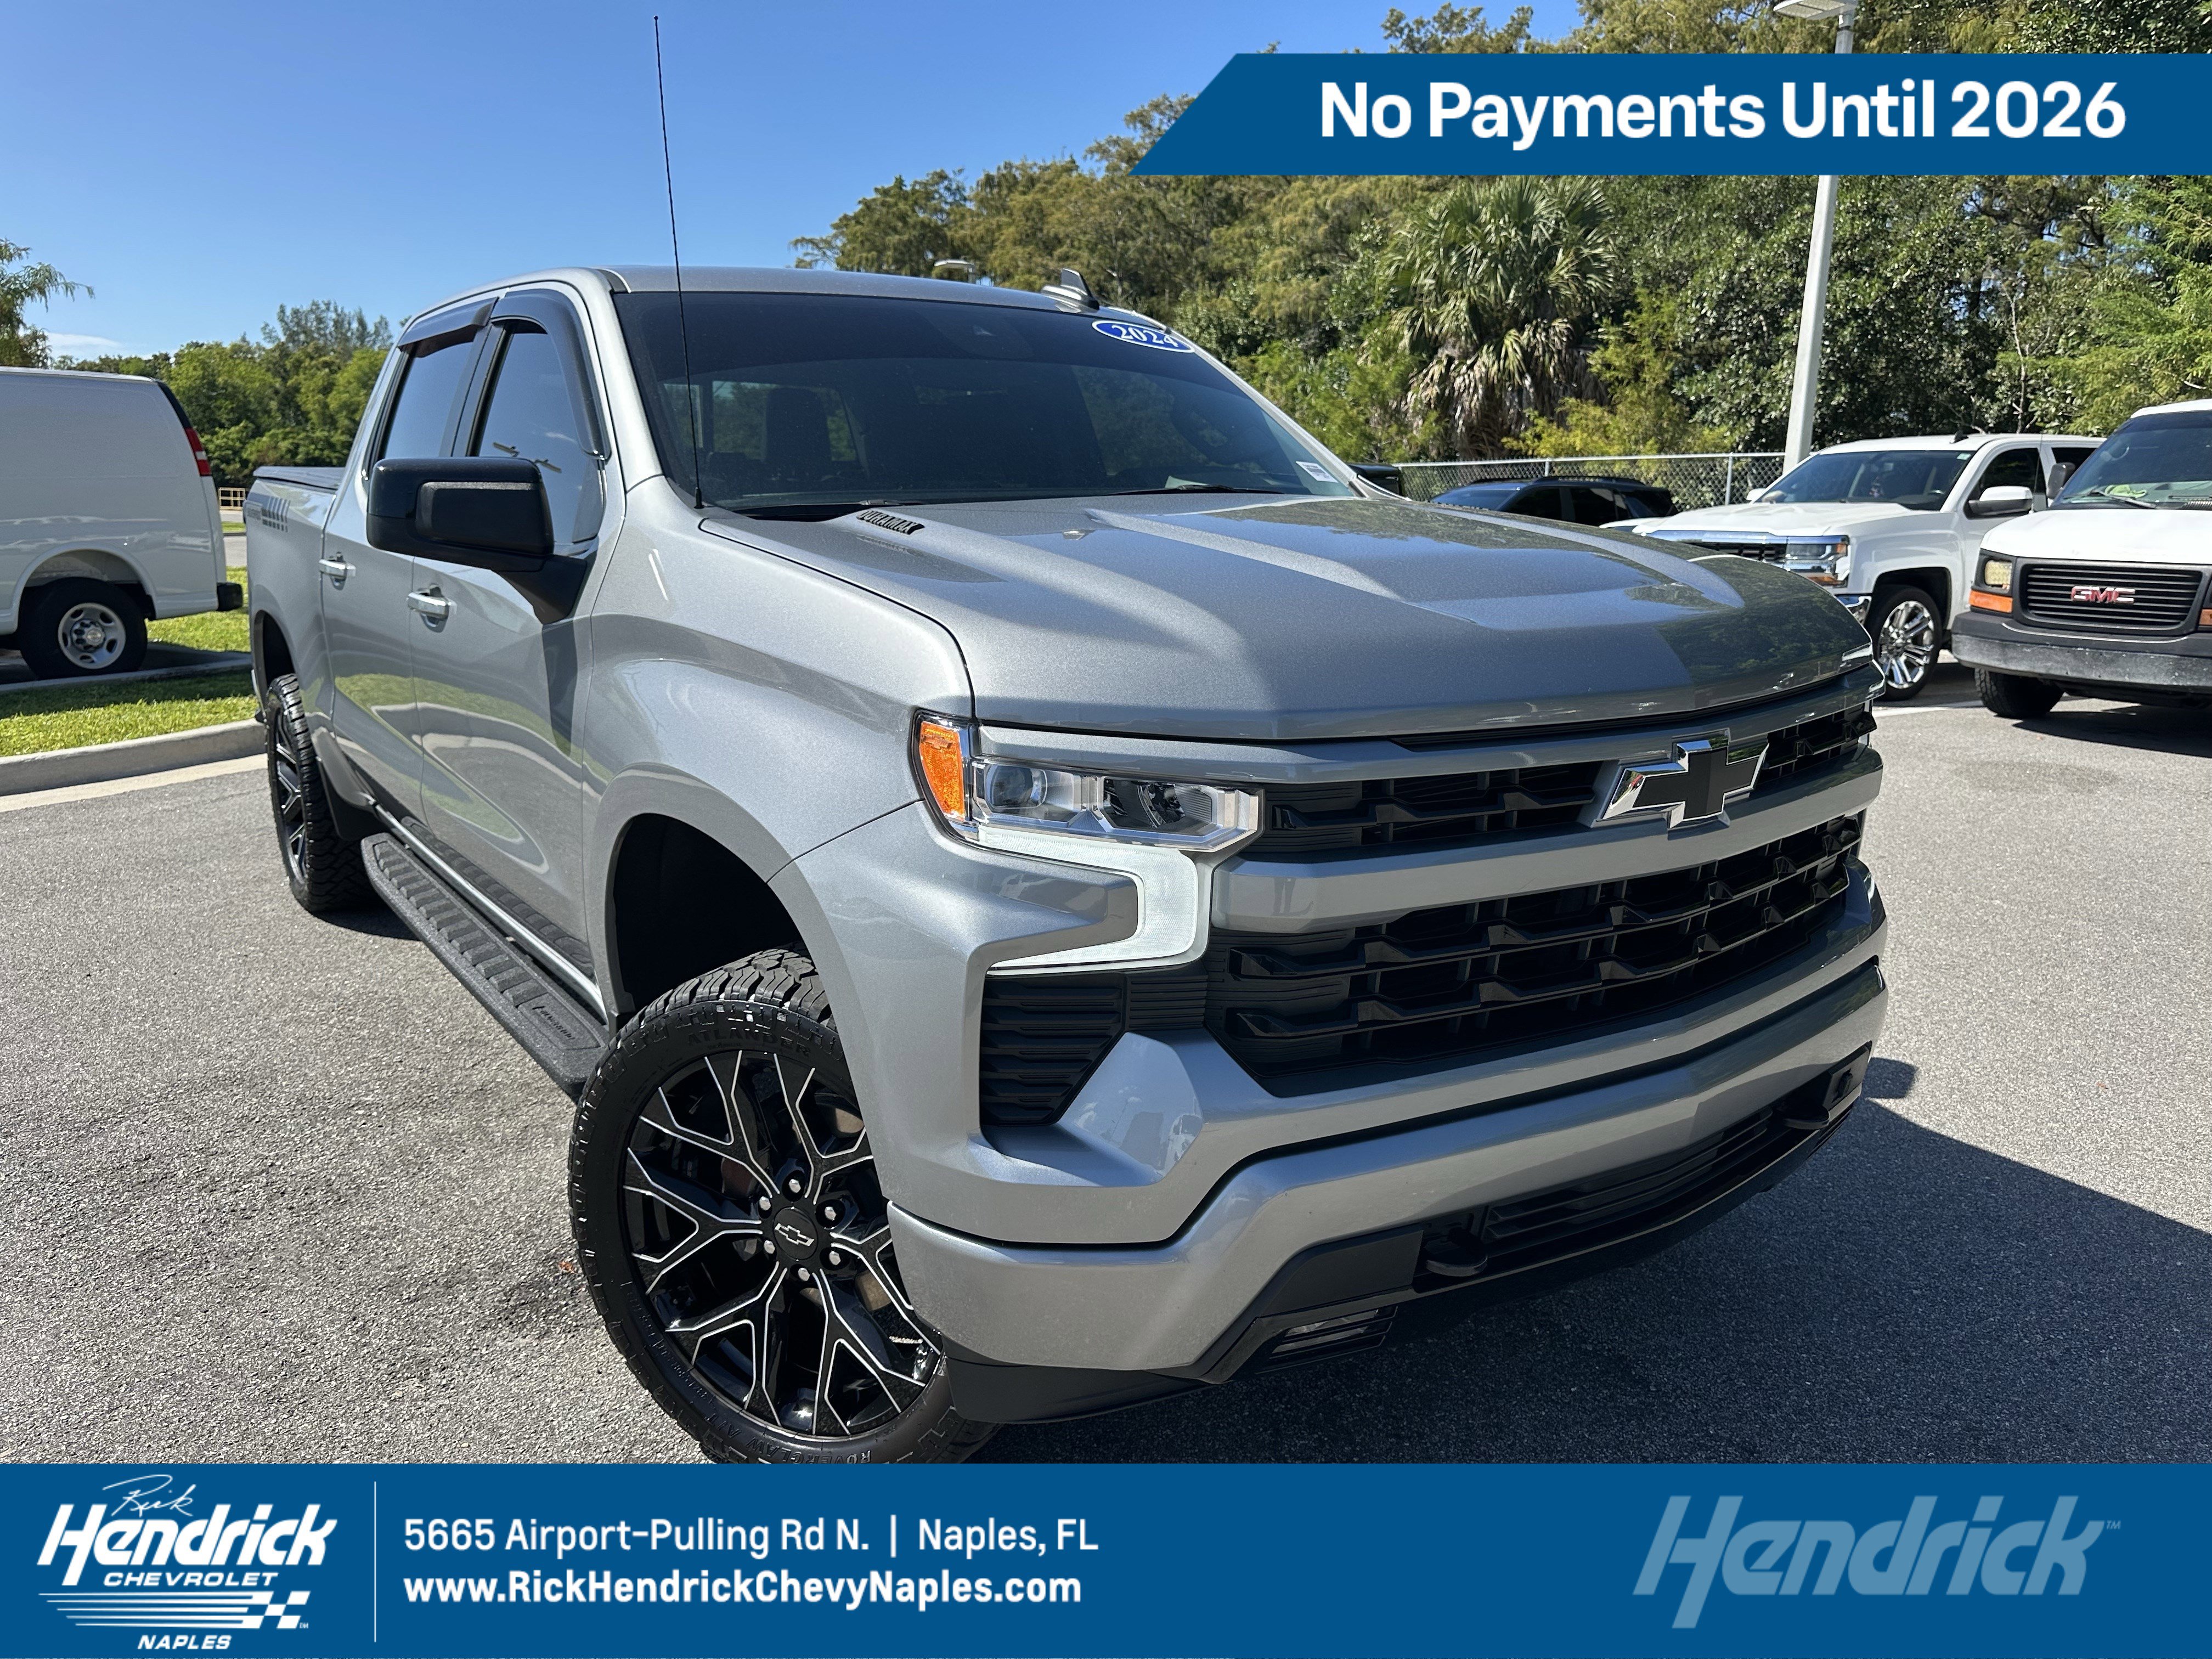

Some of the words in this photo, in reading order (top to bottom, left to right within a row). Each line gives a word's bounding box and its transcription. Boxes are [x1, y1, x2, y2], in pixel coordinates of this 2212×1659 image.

[1111, 324, 1179, 348] 2024
[856, 510, 921, 535] DURAMAX
[2070, 586, 2136, 603] GMC
[687, 1027, 812, 1057] ATLANDER
